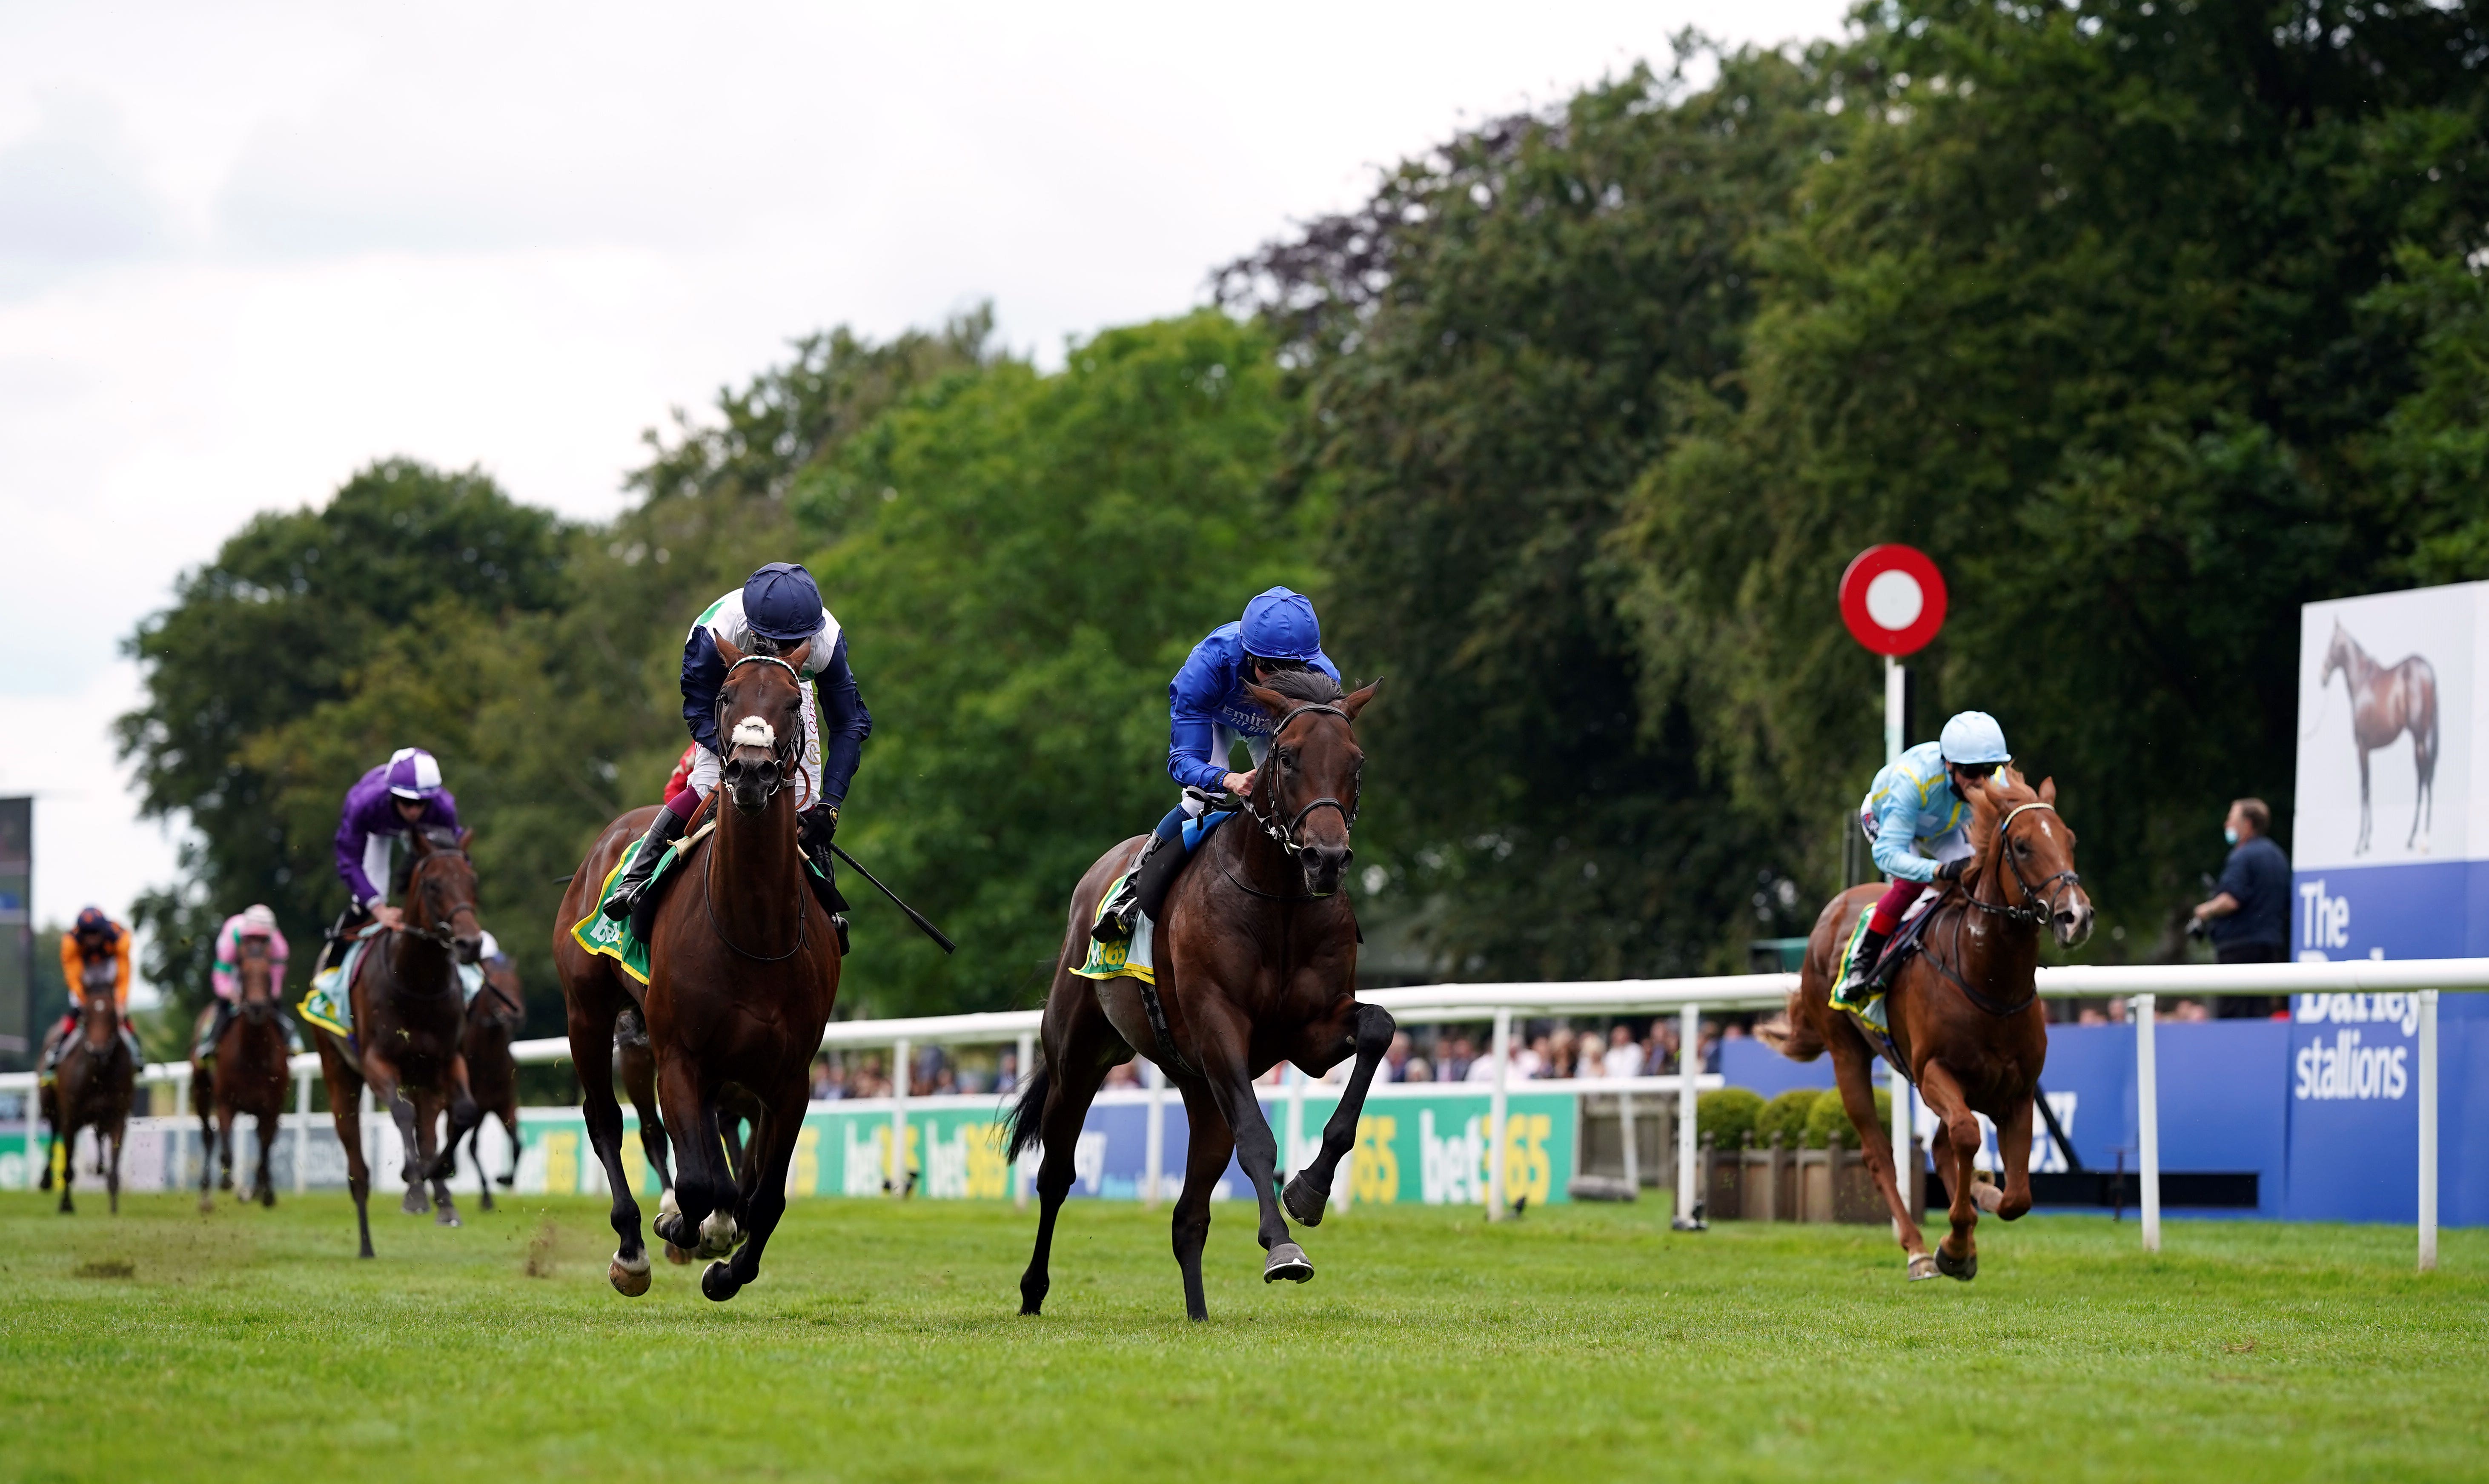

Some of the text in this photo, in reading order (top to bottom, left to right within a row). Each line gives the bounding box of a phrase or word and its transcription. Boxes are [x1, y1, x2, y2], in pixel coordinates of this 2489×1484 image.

[1231, 718, 1248, 727] FLY
[2300, 878, 2350, 949] The
[2295, 1028, 2408, 1100] stallions
